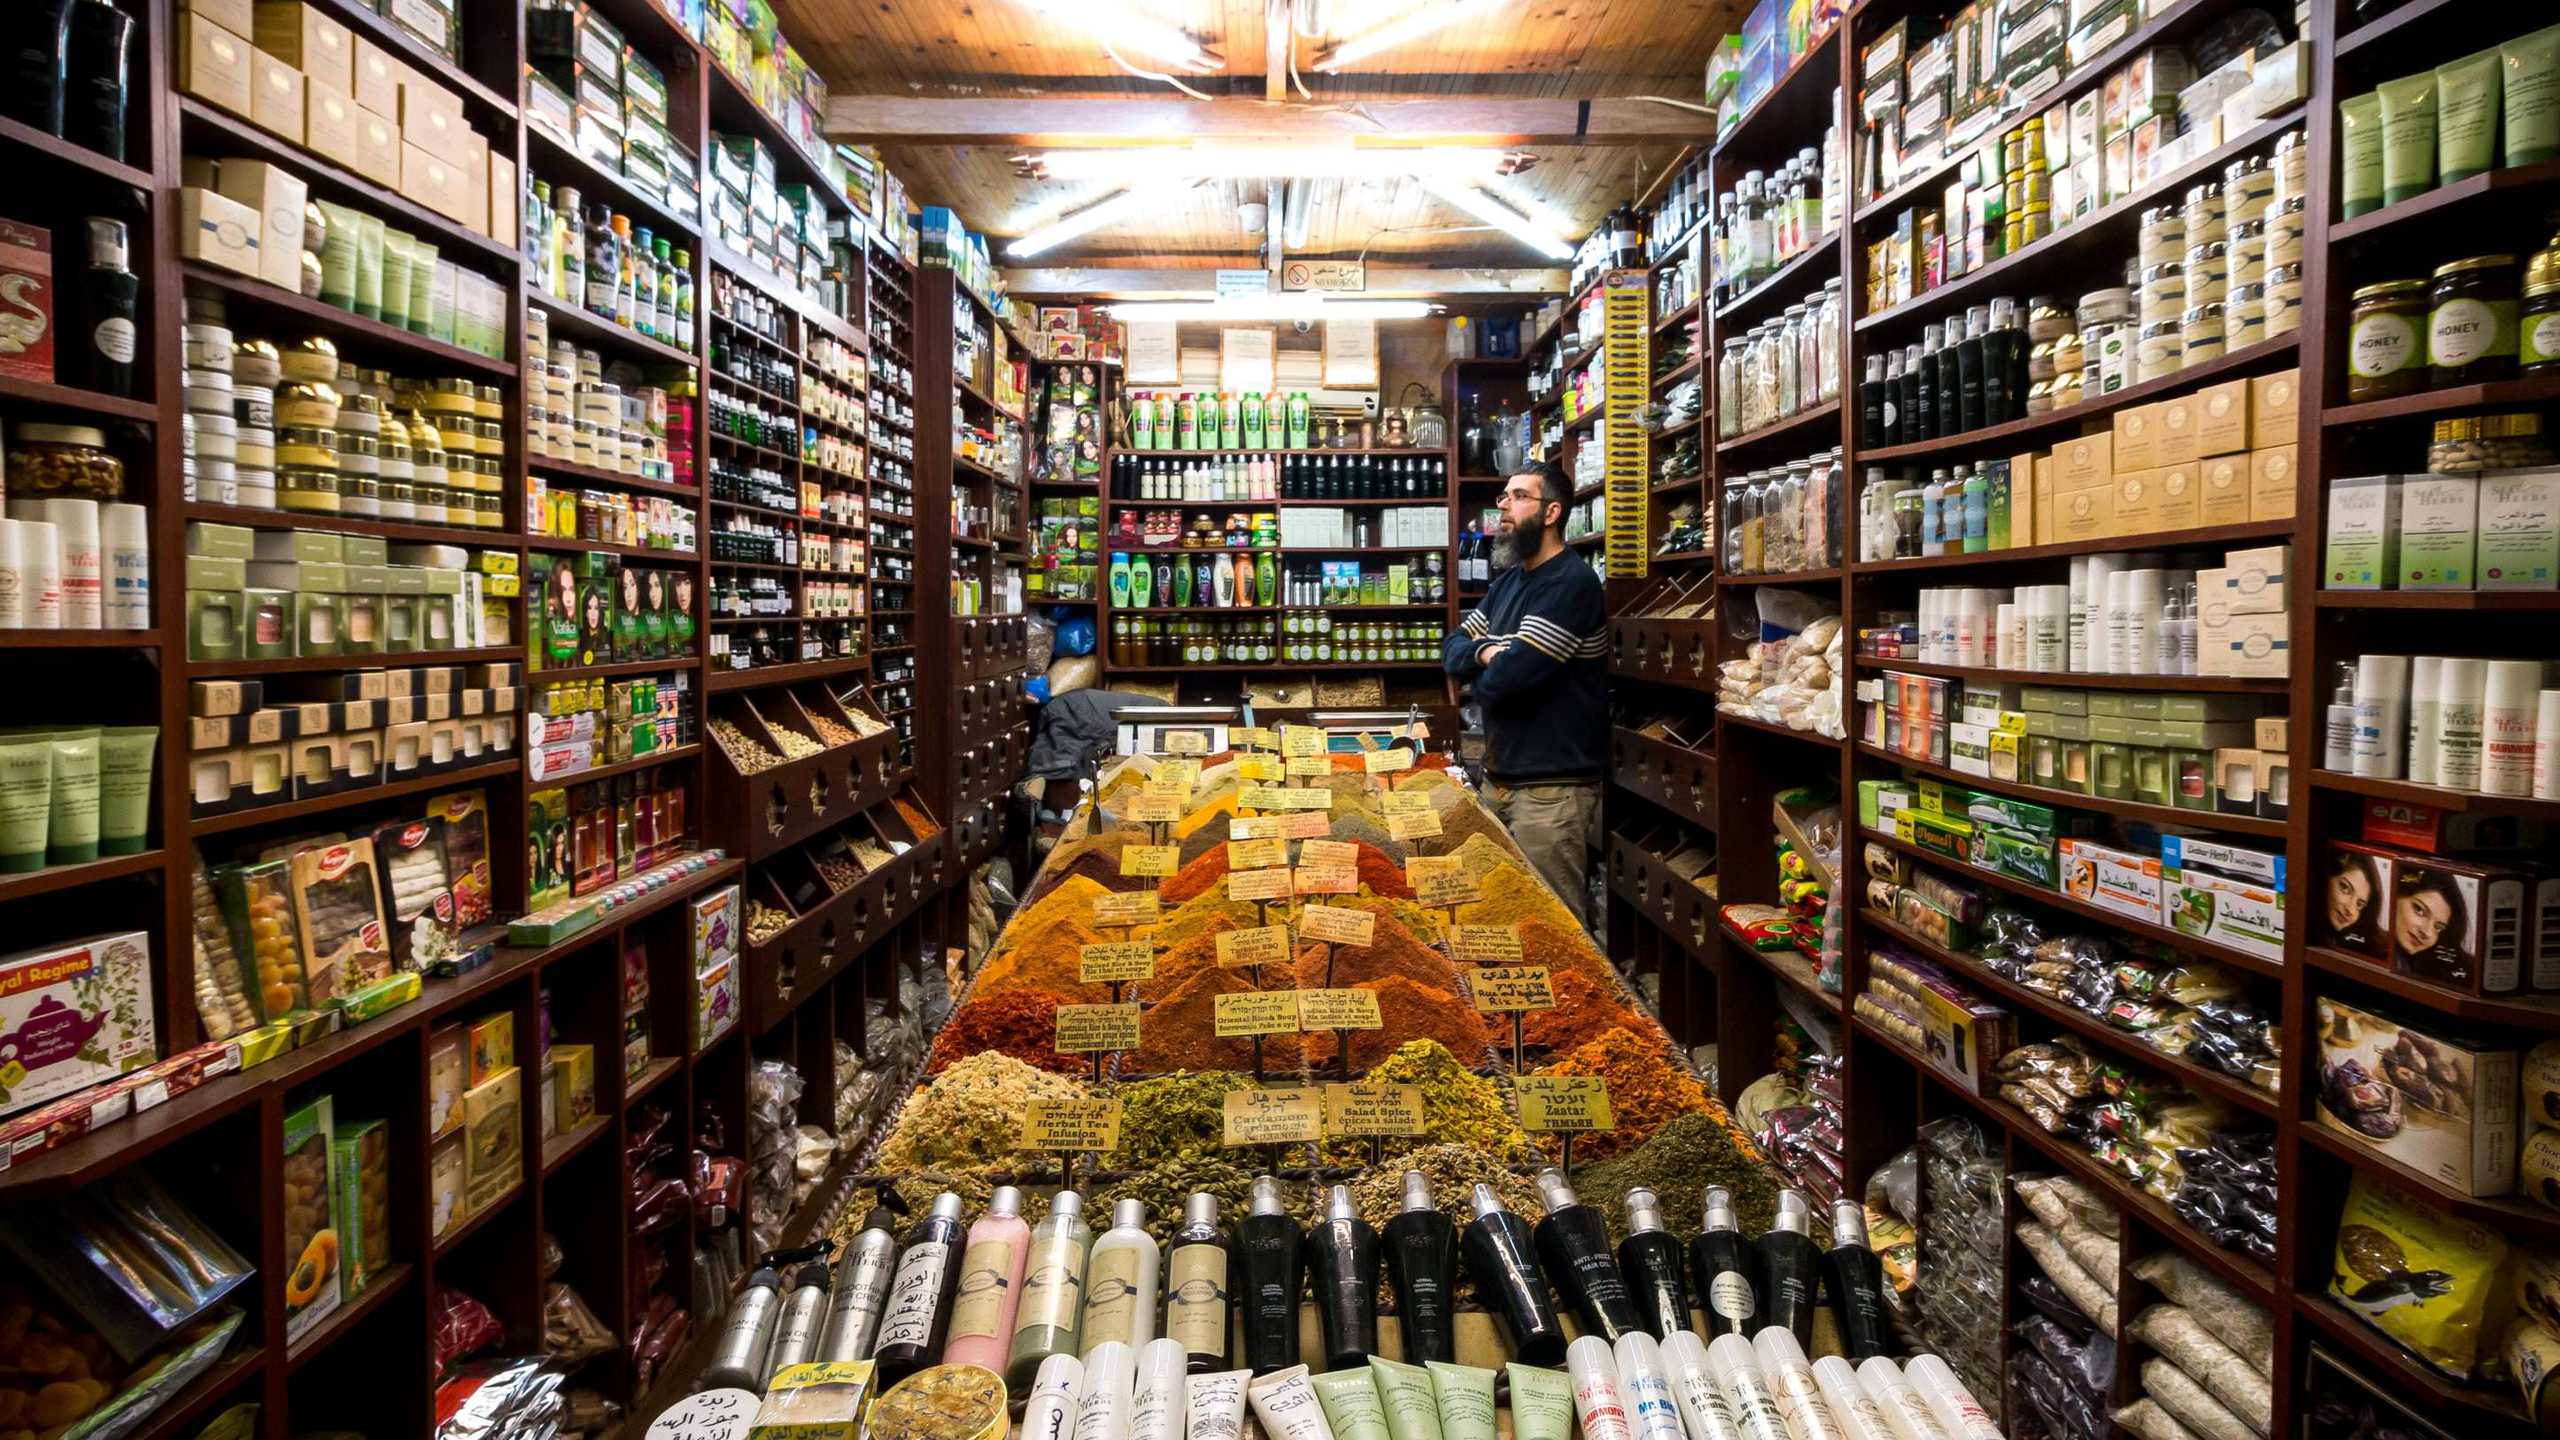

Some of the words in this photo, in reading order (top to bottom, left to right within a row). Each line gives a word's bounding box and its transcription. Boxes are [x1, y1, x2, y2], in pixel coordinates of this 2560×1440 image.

[2436, 322, 2481, 336] HONEY
[2358, 335, 2400, 349] HONEY
[29, 958, 89, 982] Regime
[1344, 1107, 1376, 1116] Salad
[1380, 1107, 1412, 1117] Spice
[1545, 1104, 1586, 1116] Zaatar
[1036, 1120, 1081, 1128] Herbal
[1087, 1120, 1109, 1128] Tea
[1232, 1113, 1309, 1124] Cardamom
[1047, 1128, 1096, 1138] Infusion
[699, 1394, 737, 1410] زبدة
[1638, 1400, 1655, 1415] Mr.
